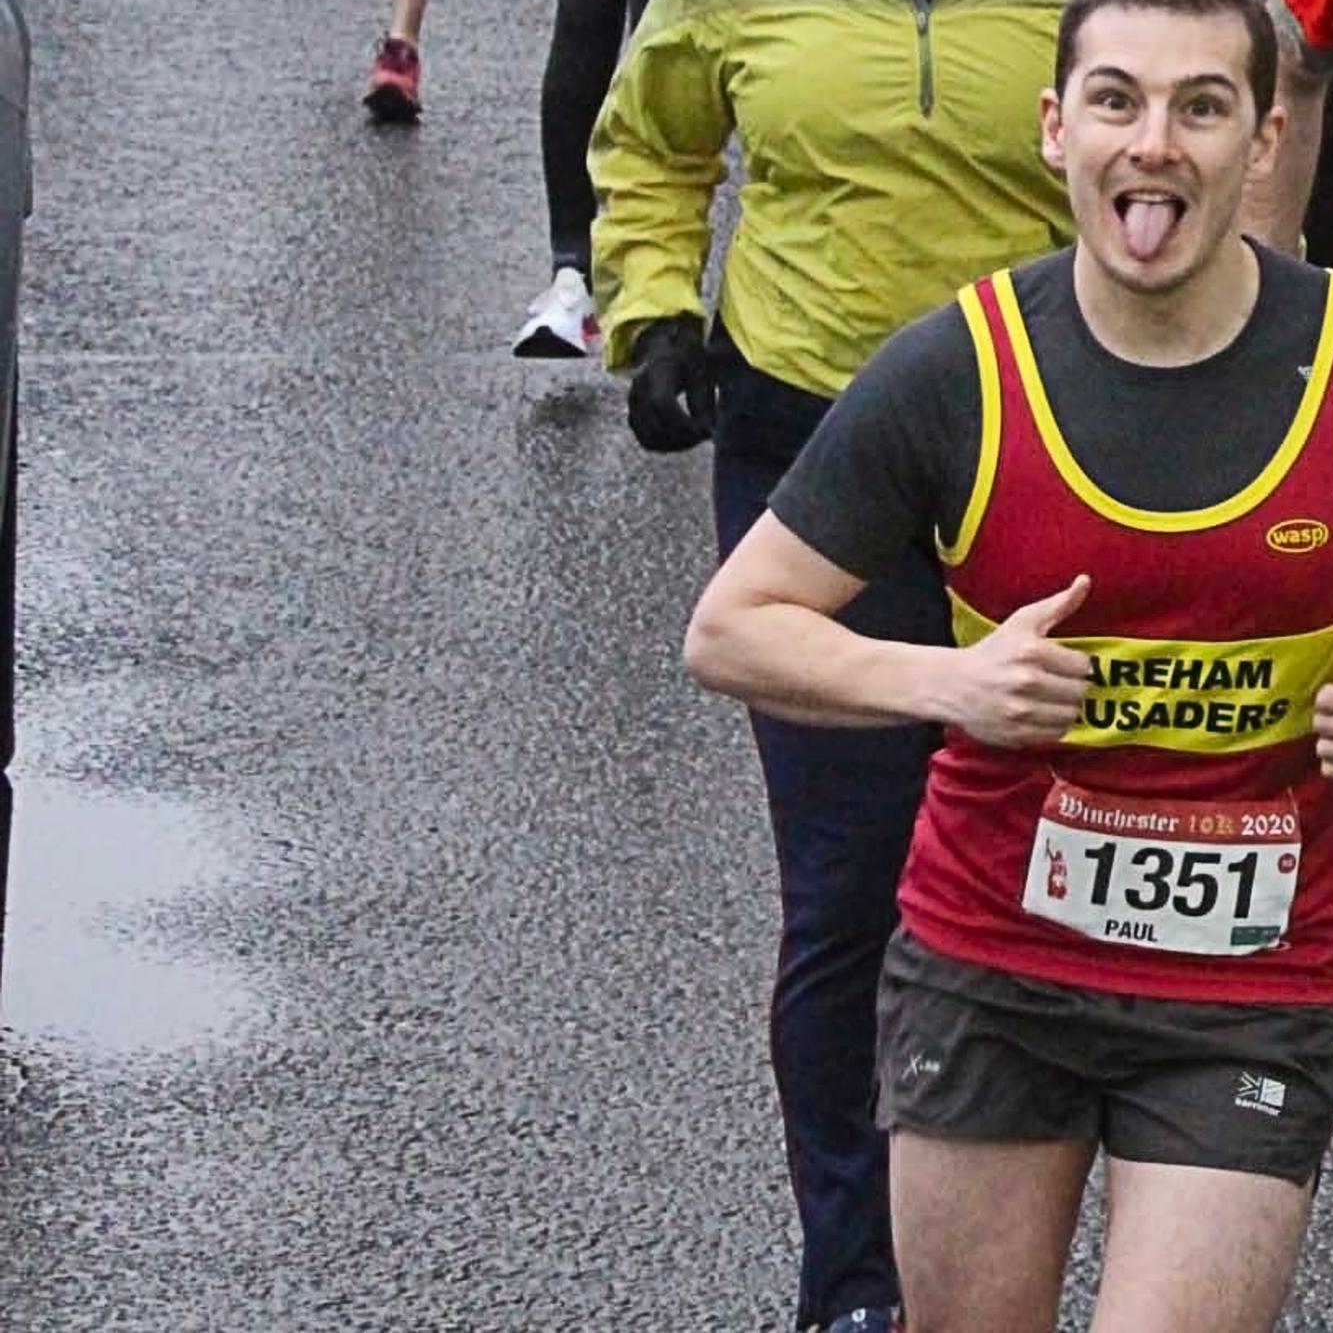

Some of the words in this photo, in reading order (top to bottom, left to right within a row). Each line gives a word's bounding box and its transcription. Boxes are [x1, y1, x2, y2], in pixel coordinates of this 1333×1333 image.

[1272, 524, 1325, 548] wasp
[1086, 655, 1273, 691] AREHAM
[1080, 697, 1291, 734] USADERS
[1058, 793, 1180, 834] Winchester
[1189, 817, 1235, 835] 10K
[1240, 813, 1297, 837] 2020
[1084, 841, 1259, 920] 1351
[1104, 919, 1158, 943] PAUL
